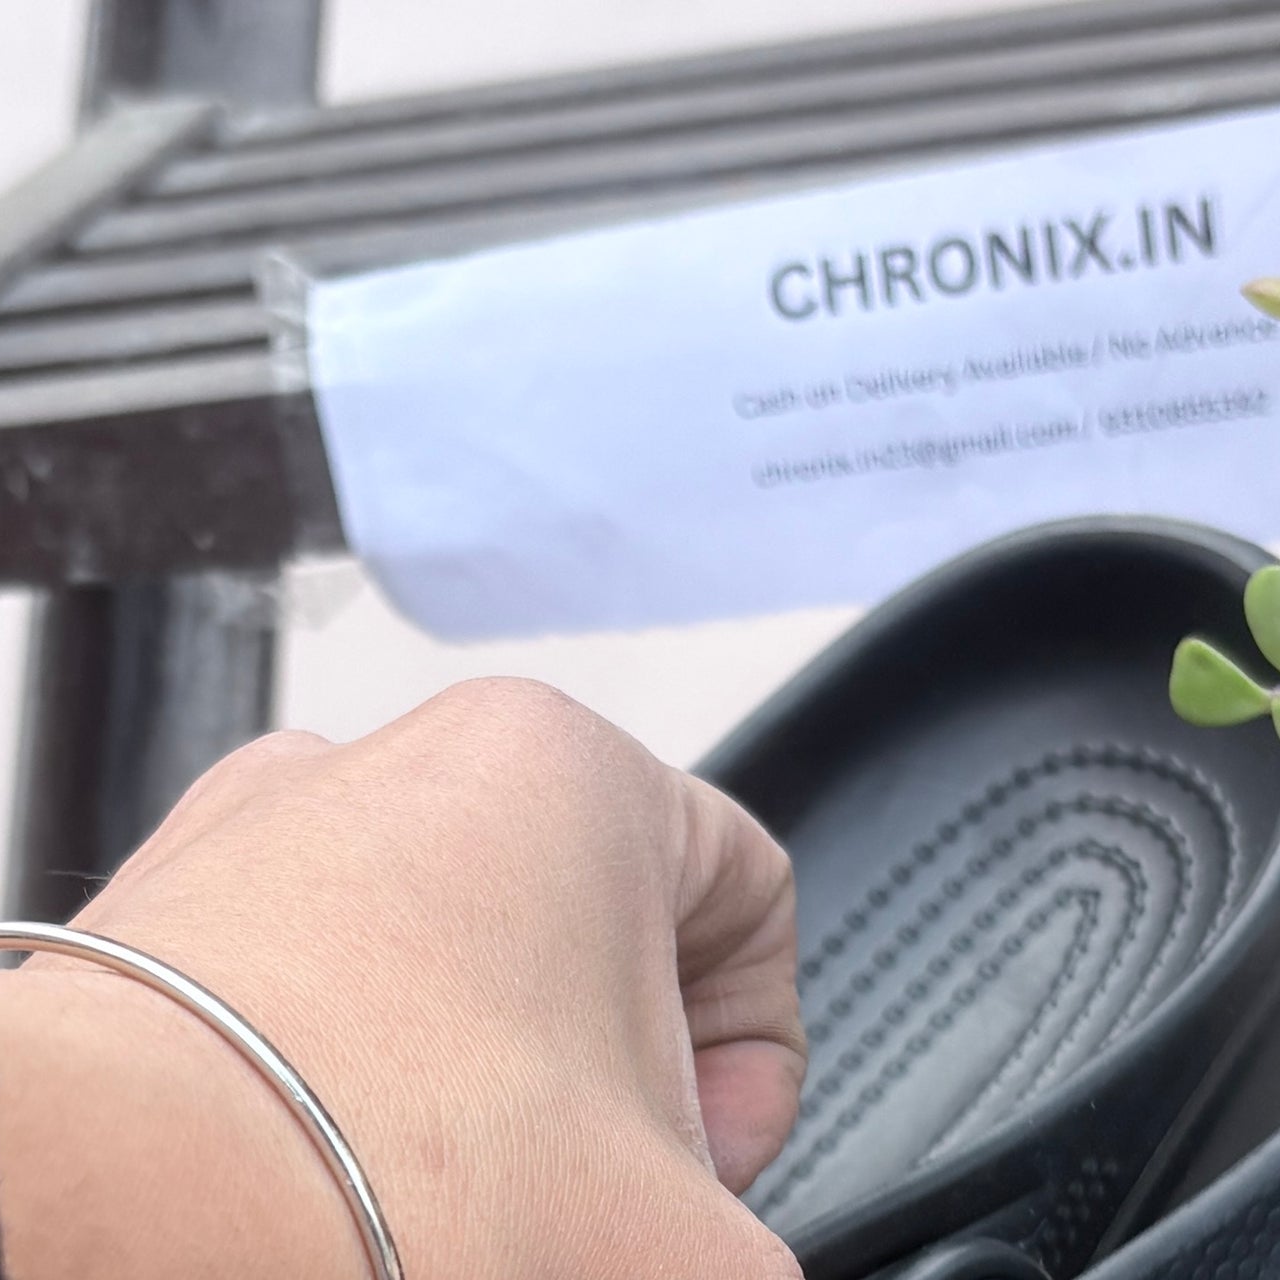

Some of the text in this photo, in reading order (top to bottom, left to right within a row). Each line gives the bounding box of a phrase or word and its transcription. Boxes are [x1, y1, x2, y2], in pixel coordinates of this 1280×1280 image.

[768, 195, 1218, 321] CHRONIX.IN
[844, 361, 958, 404] Delivery
[962, 338, 1089, 381] Available
[1154, 316, 1278, 353] Advance
